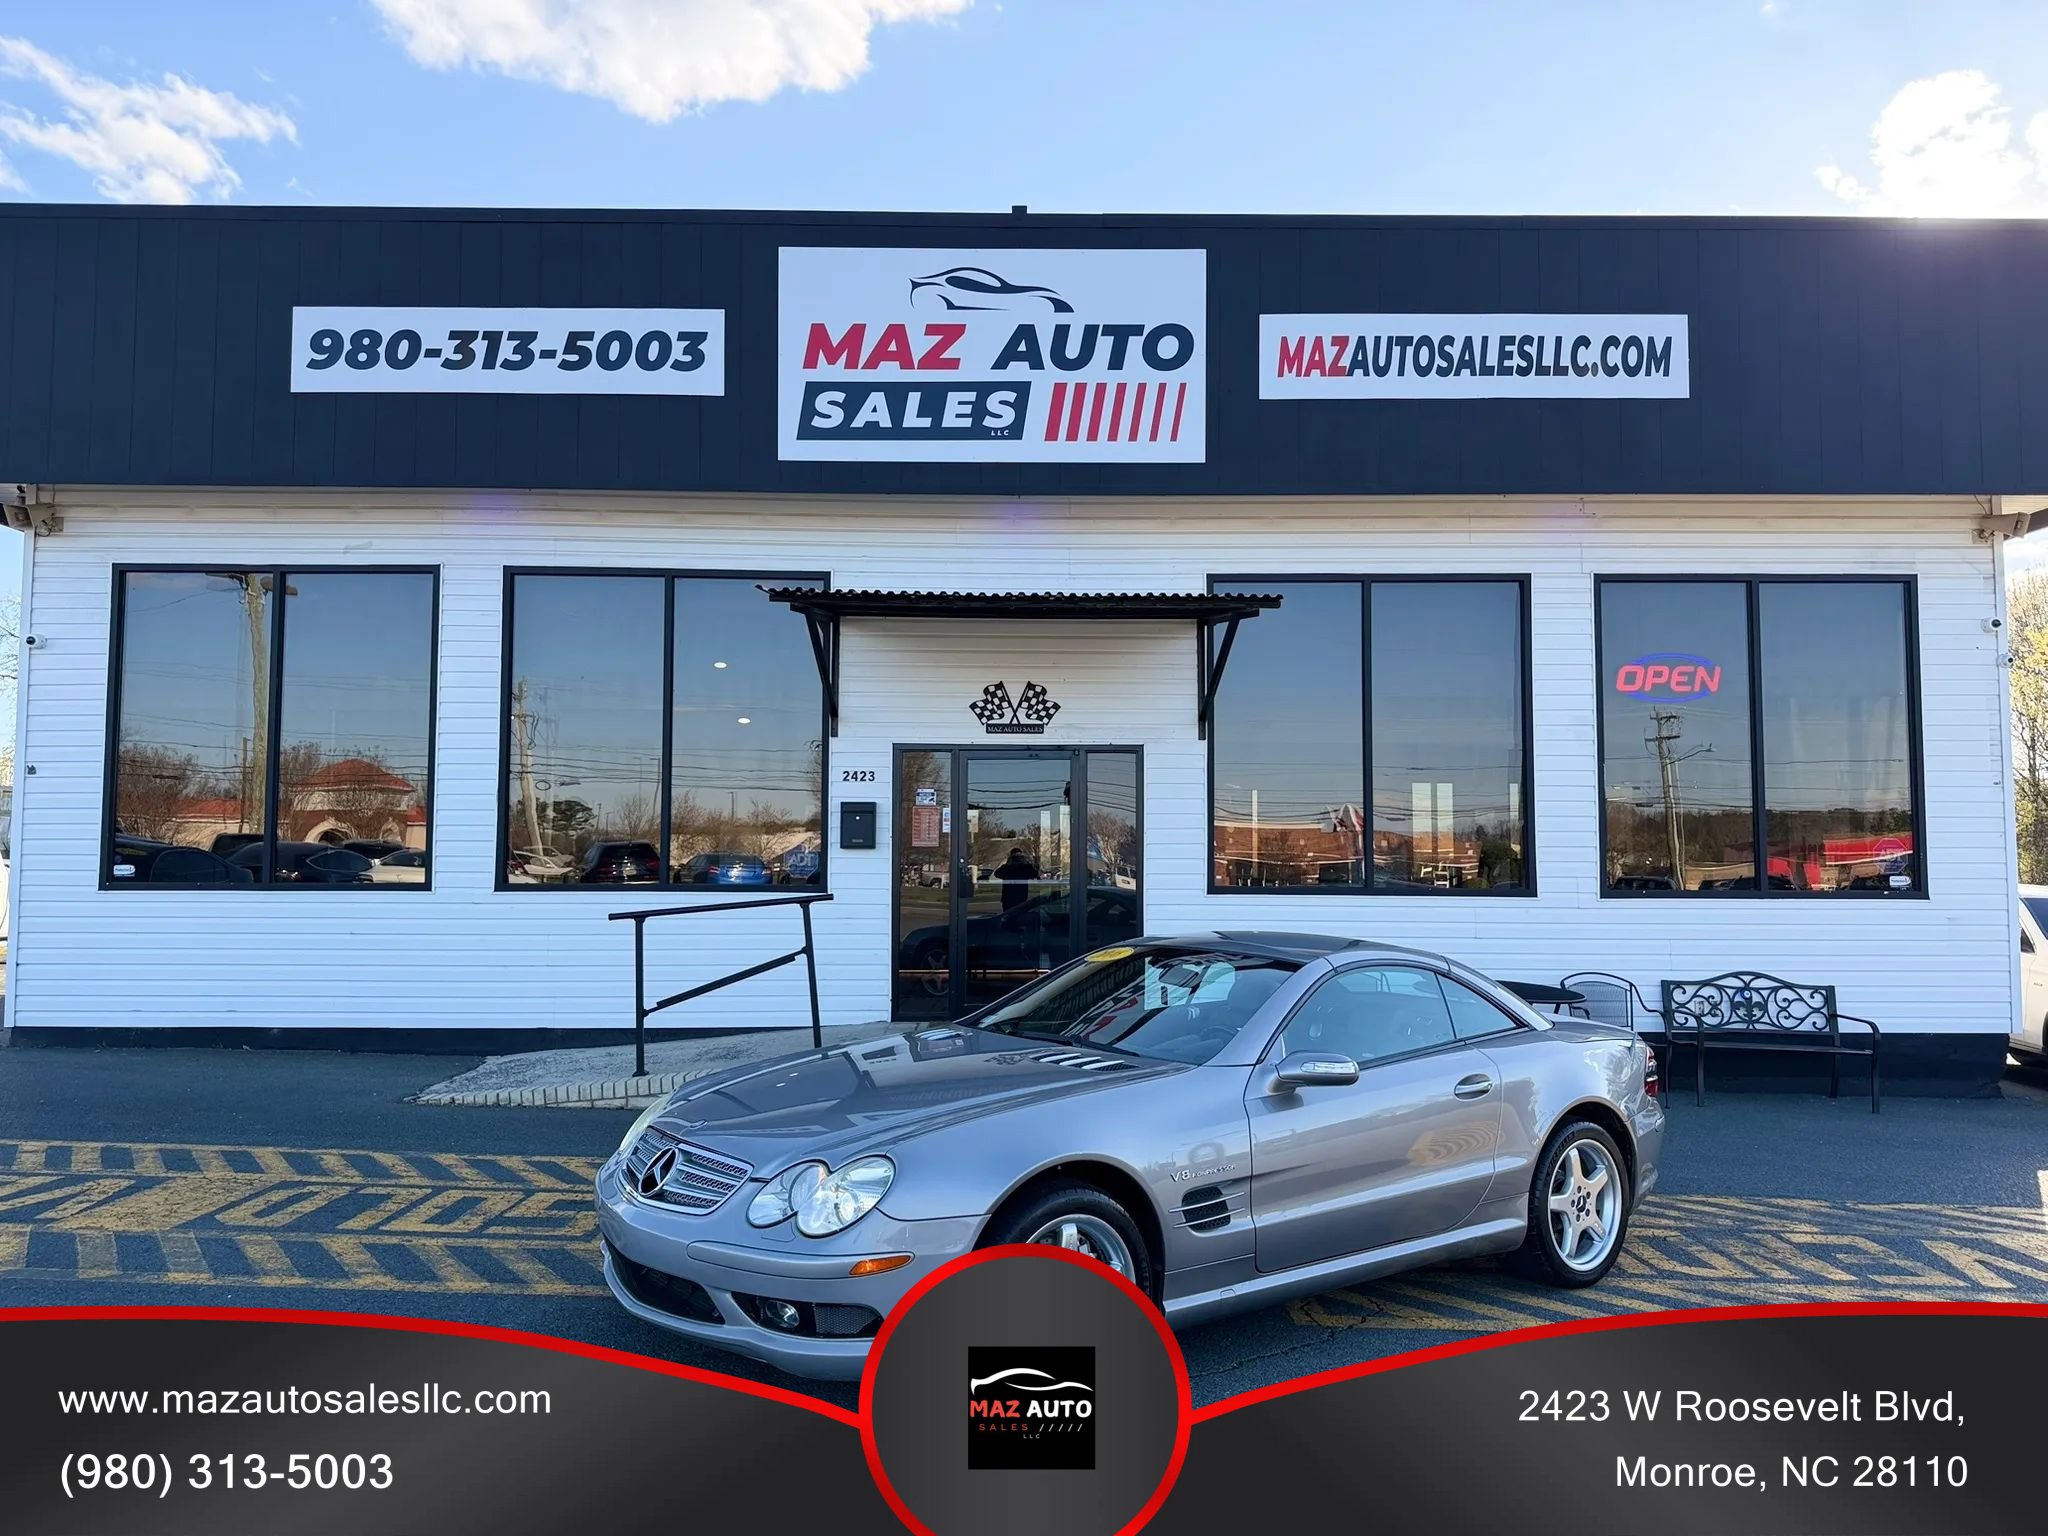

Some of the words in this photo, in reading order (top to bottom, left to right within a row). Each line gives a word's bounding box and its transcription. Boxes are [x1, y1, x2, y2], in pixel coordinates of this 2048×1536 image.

[305, 329, 709, 373] 980-313-5003
[803, 323, 966, 370] MAZ
[990, 323, 1195, 372] AUTO
[1277, 334, 1673, 378] MAZAUTOSALESLLC.COM
[811, 390, 1017, 428] SALES
[1615, 664, 1721, 693] OPEN
[842, 770, 876, 782] 2423
[788, 853, 815, 867] ADT
[1170, 1169, 1191, 1183] V8
